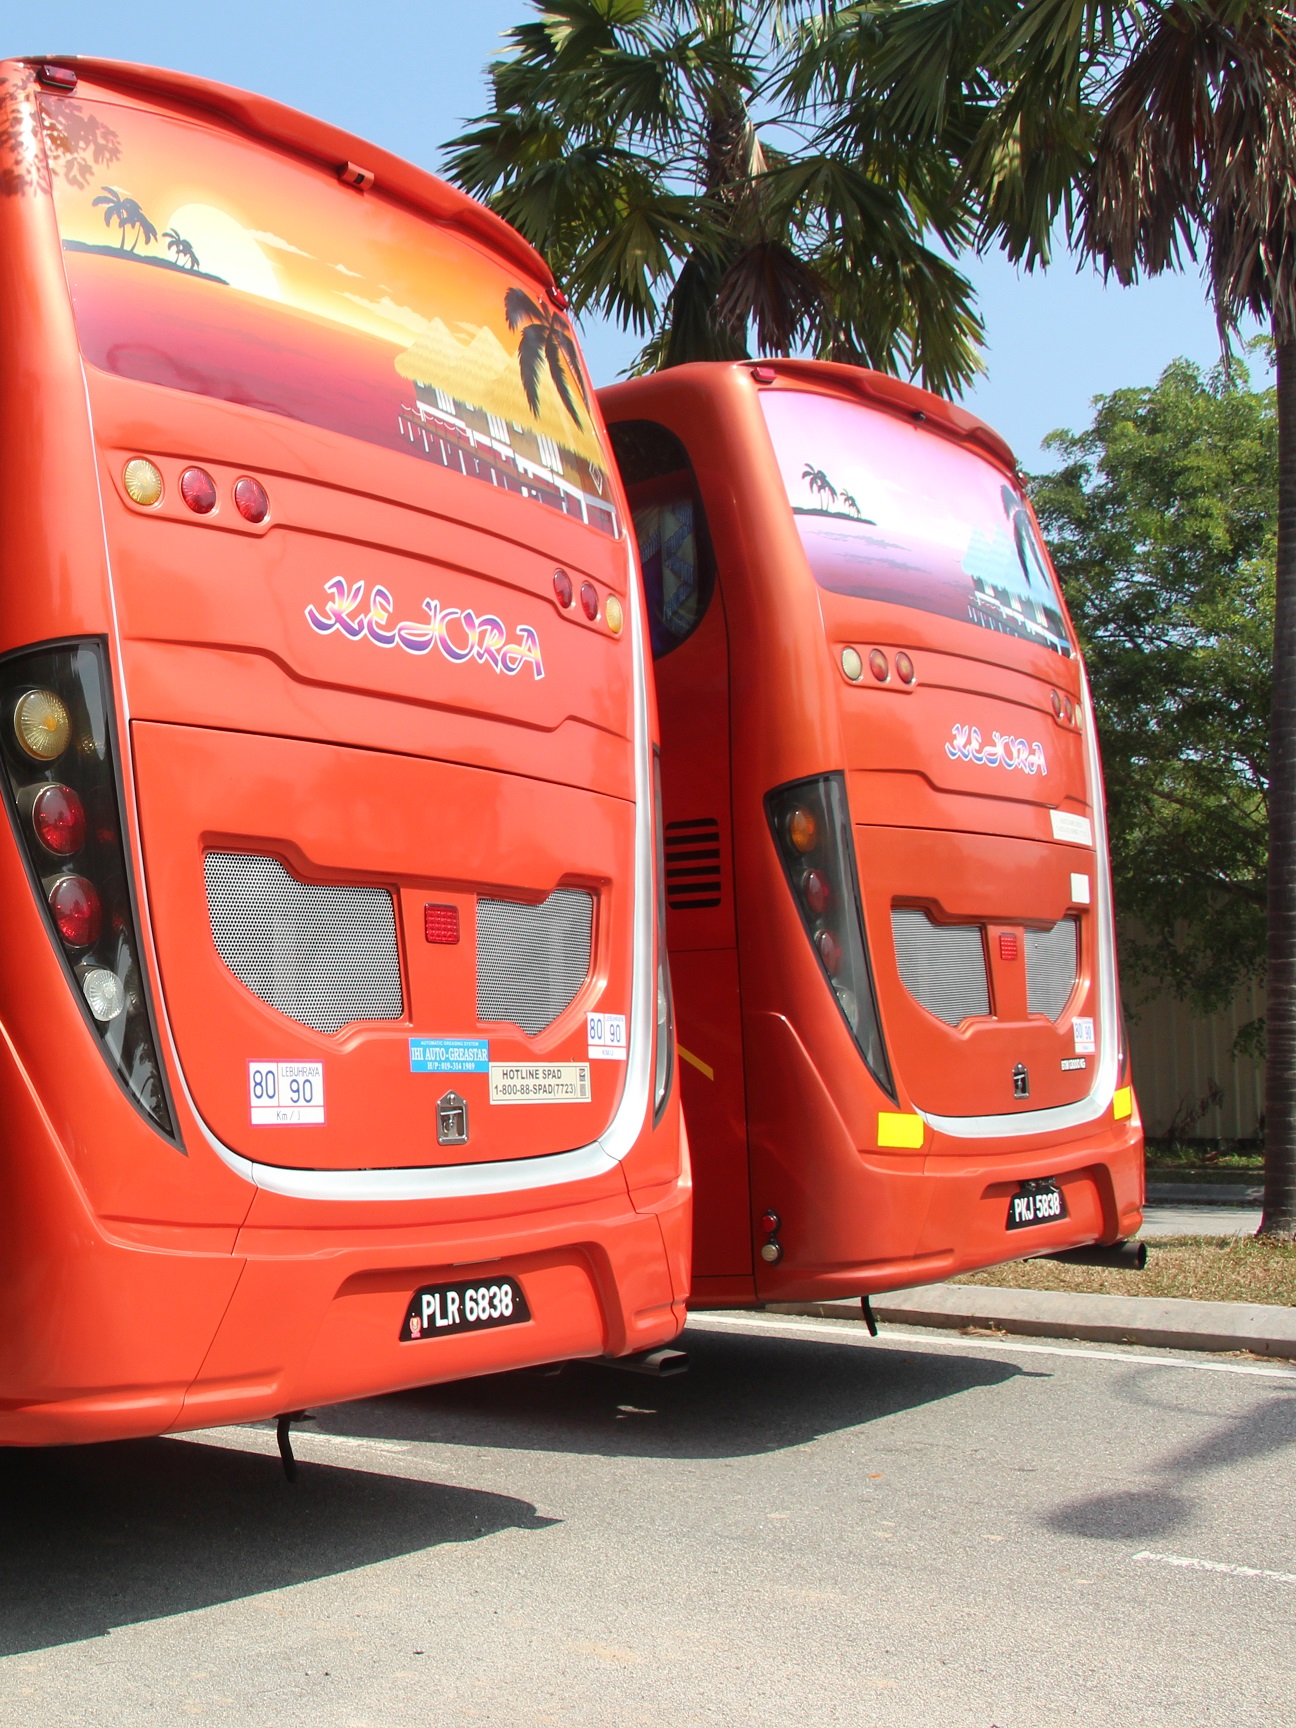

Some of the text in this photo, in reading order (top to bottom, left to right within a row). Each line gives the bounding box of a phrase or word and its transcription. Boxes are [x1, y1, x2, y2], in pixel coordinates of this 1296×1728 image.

[304, 576, 545, 680] KEJORA
[945, 723, 1047, 776] KEJORA
[590, 1018, 603, 1039] 80
[609, 1024, 621, 1043] 90
[411, 1047, 488, 1061] IHI AUTO-GREASTAR
[281, 1066, 320, 1077] LEBUHRAYA
[502, 1069, 562, 1080] HOTLINE SPAD
[253, 1070, 276, 1099] 80
[290, 1079, 313, 1103] 90
[494, 1084, 576, 1096] 1-800-88-SPAD(7723)
[1014, 1192, 1060, 1222] PKJ 5838
[421, 1284, 513, 1329] PLR 6838
